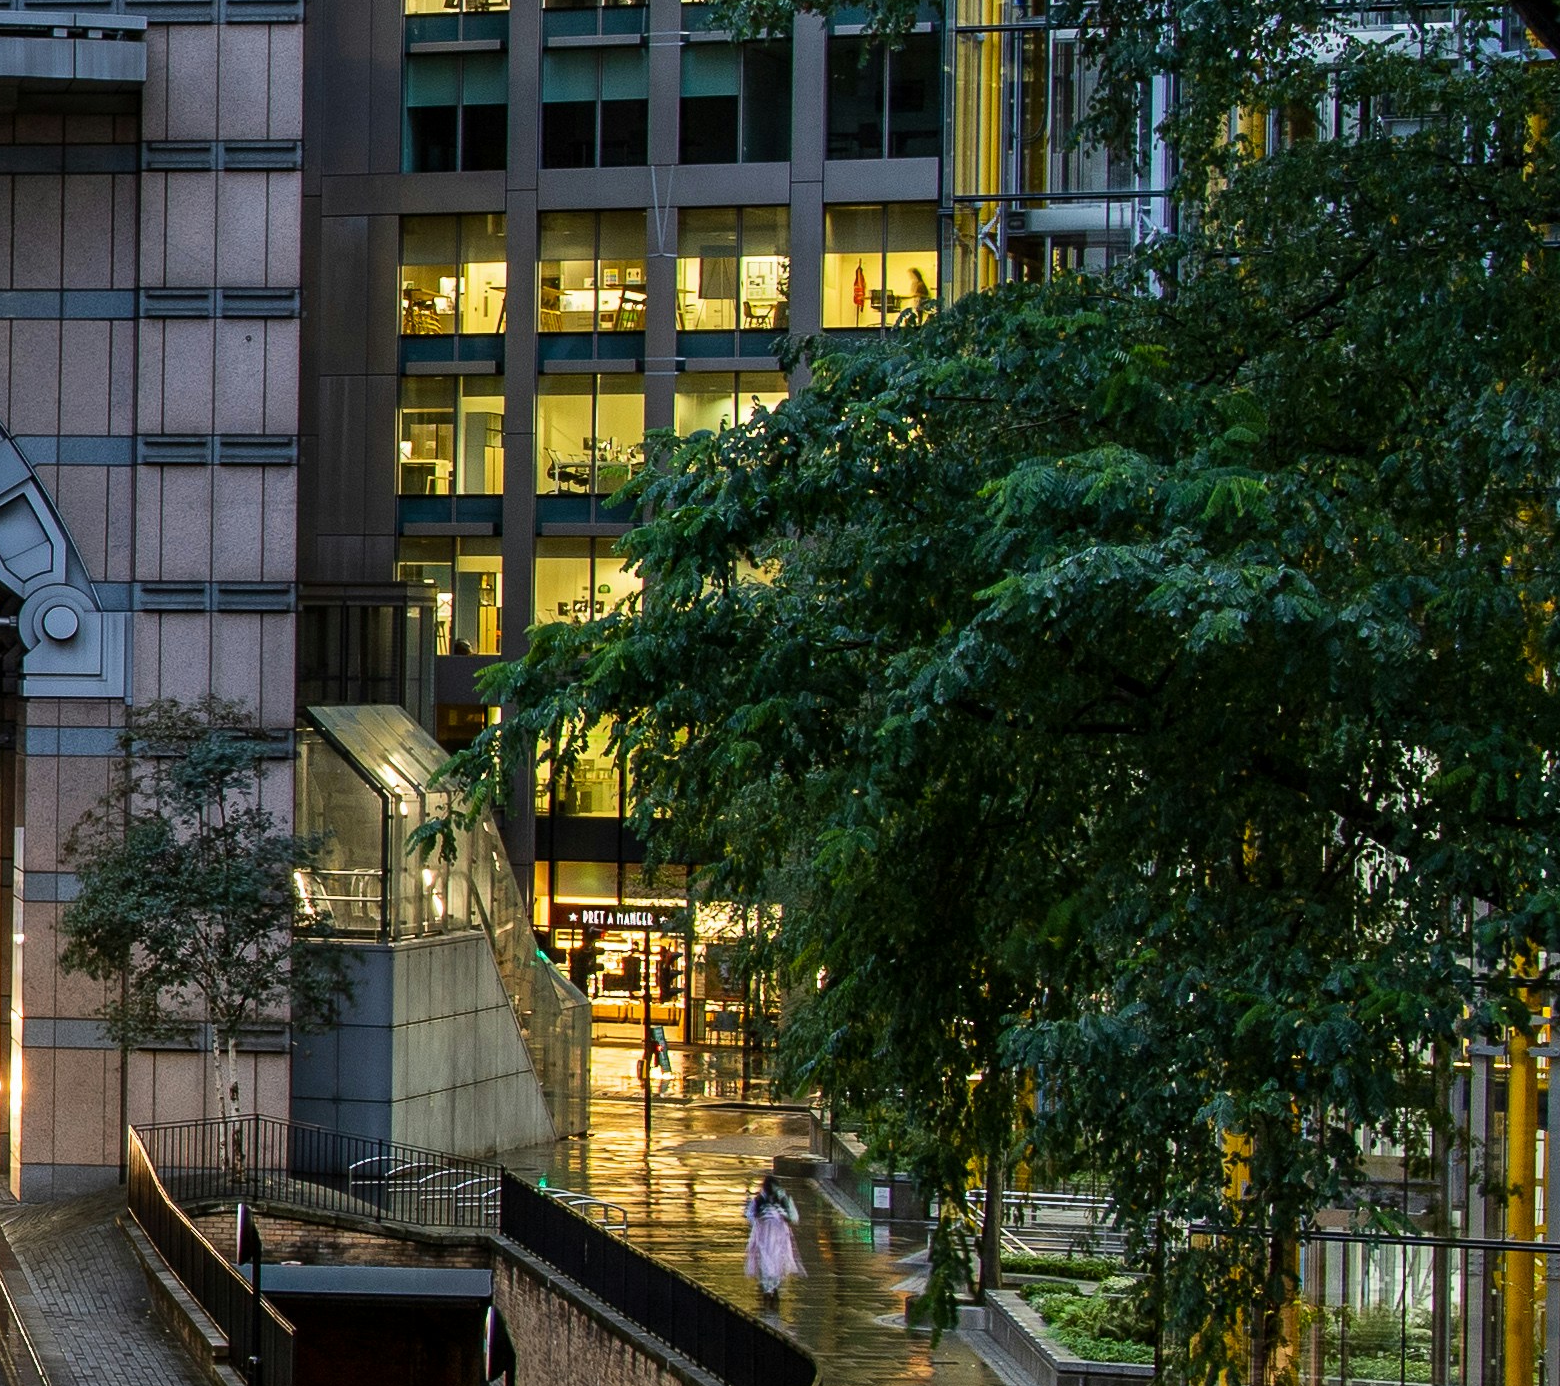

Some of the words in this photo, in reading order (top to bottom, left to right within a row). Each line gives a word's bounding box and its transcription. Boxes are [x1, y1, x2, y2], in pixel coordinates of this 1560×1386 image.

[582, 910, 605, 924] PRET
[607, 912, 614, 924] A
[616, 912, 654, 926] MANGER
